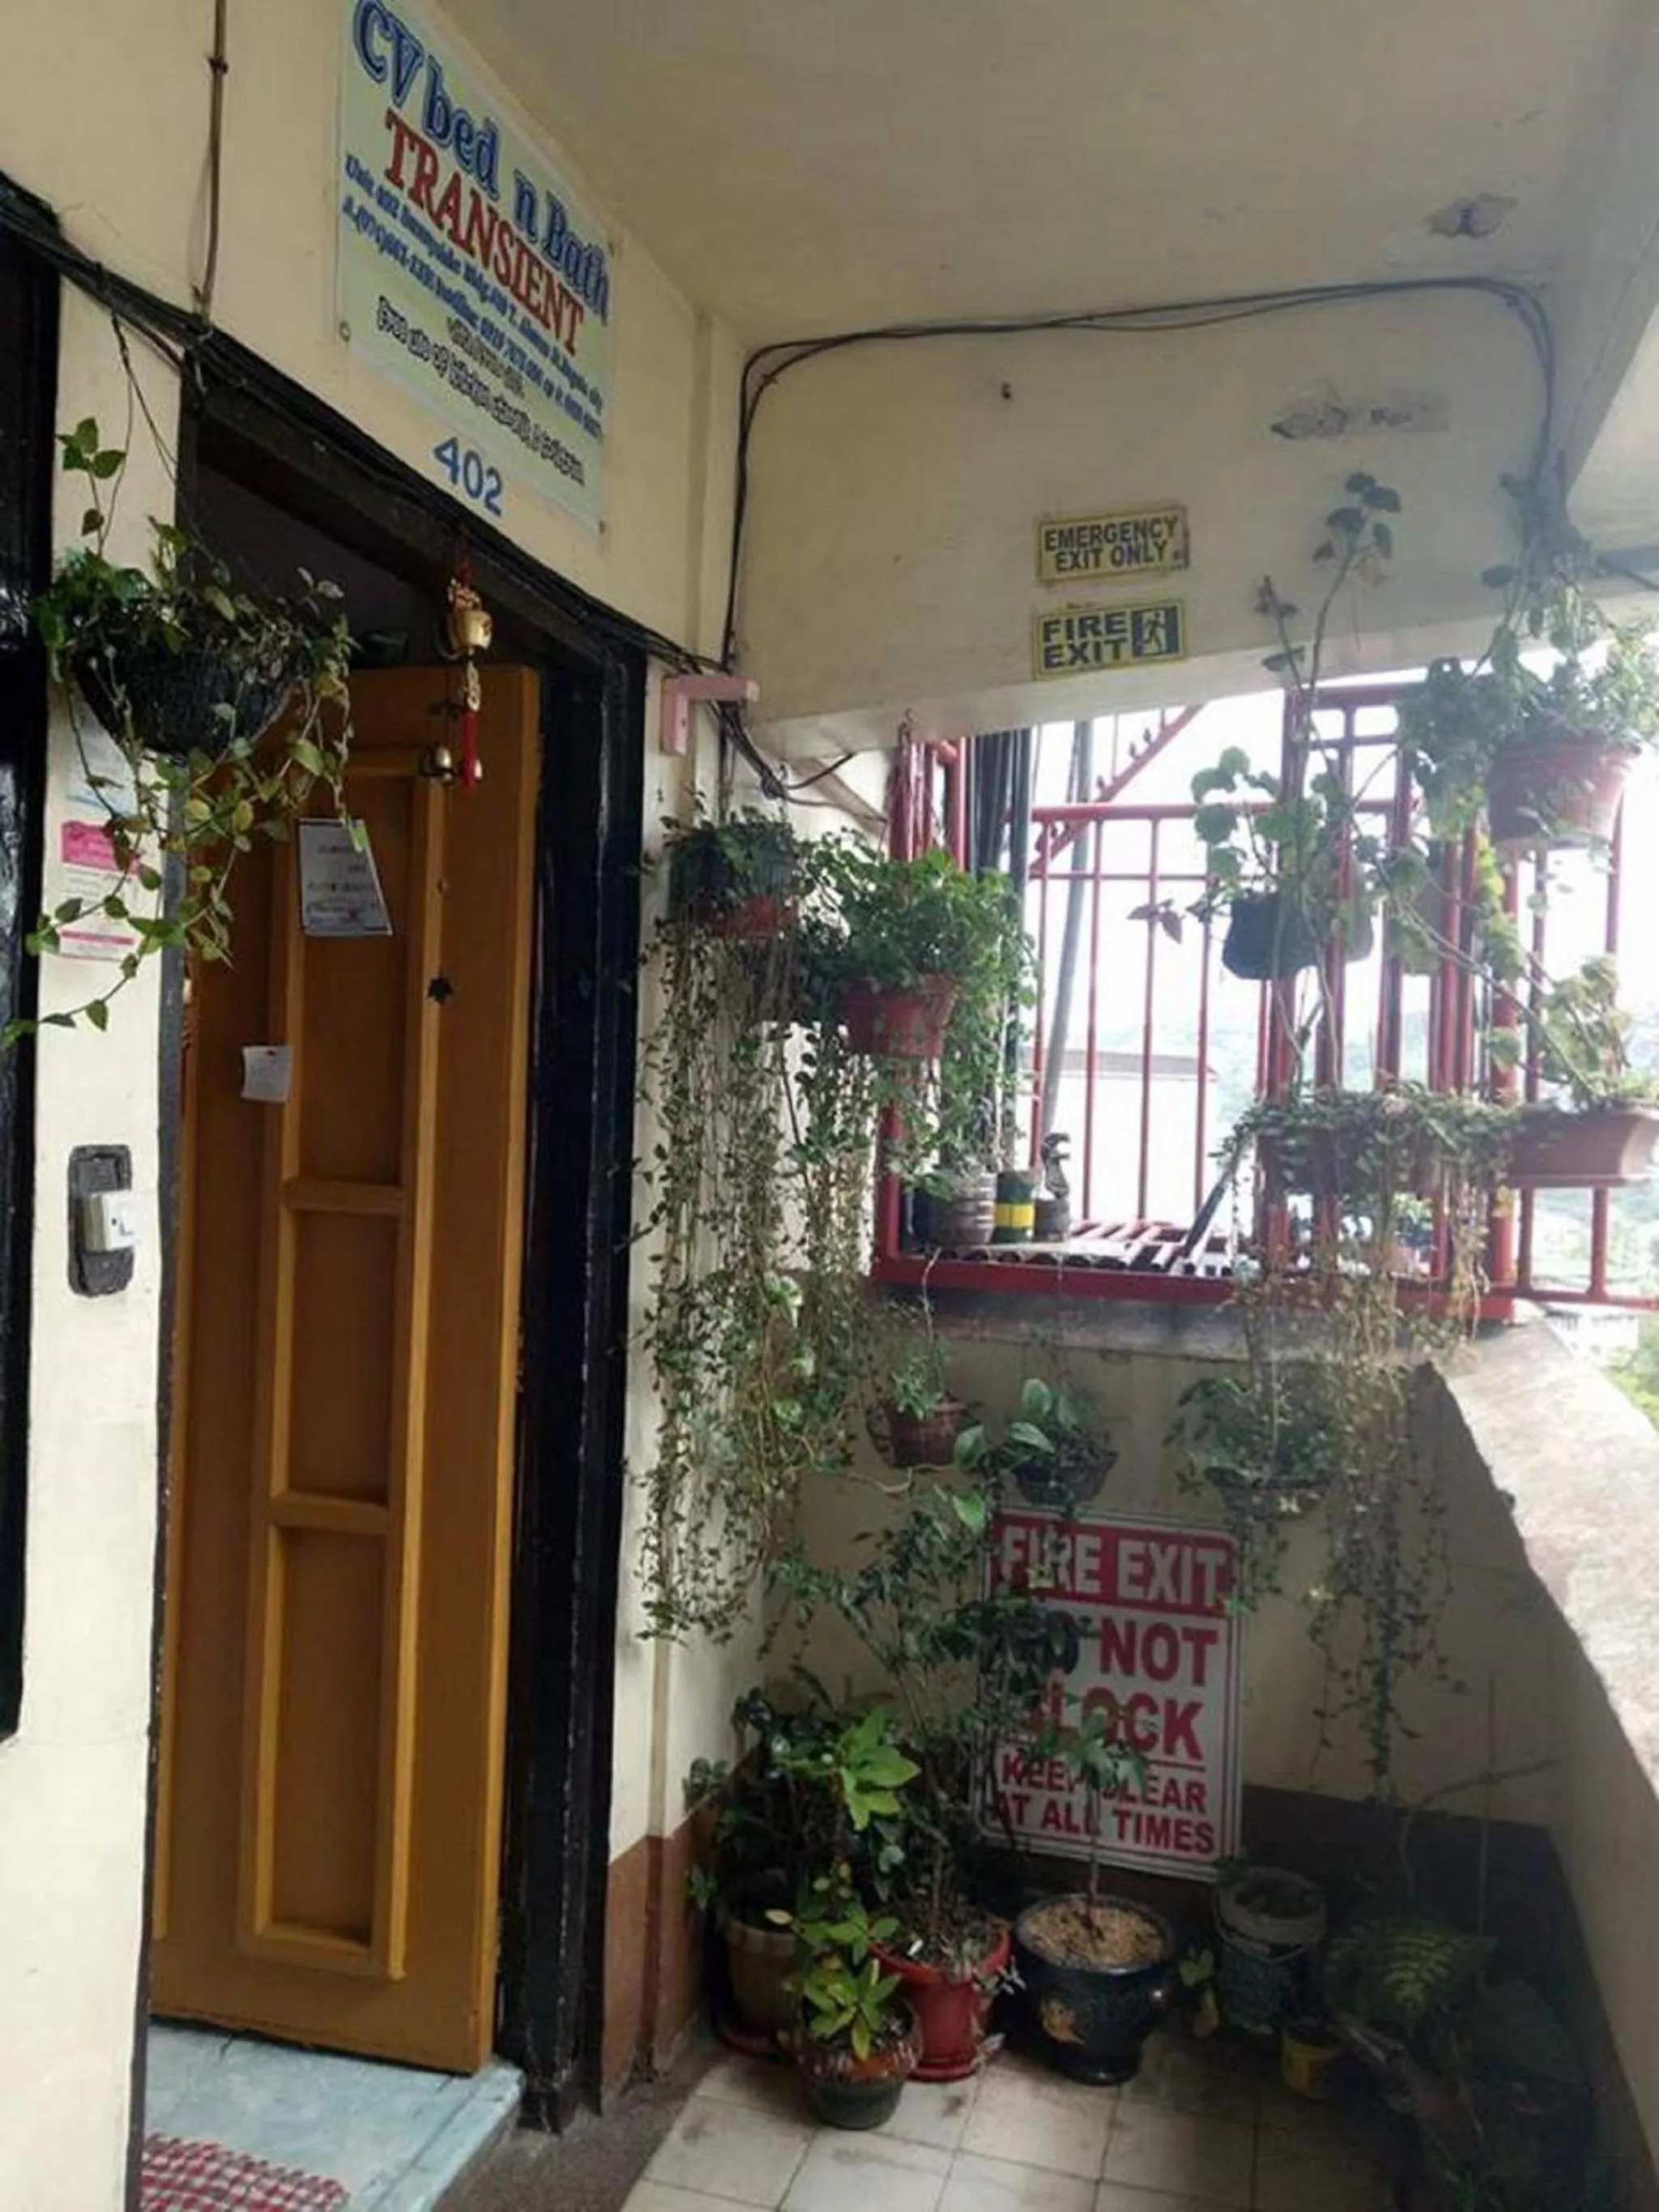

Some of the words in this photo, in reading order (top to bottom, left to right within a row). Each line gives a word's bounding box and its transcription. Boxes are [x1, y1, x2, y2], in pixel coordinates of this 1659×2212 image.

[353, 0, 425, 108] CV
[421, 53, 501, 203] bed
[514, 168, 539, 244] n
[384, 107, 584, 357] TRANSIENT
[433, 436, 503, 517] 402
[1044, 515, 1179, 552] EMERGENCY
[1056, 547, 1102, 573] EXIT
[1110, 540, 1168, 568] ONLY
[1043, 611, 1128, 643] FIRE
[1043, 637, 1128, 670] EXIT
[1001, 1526, 1102, 1595] FIRE
[1118, 1538, 1227, 1608] EXIT
[1098, 1616, 1218, 1687] NOT
[1021, 1677, 1205, 1761] LOCK
[1111, 1808, 1215, 1855] TIMES
